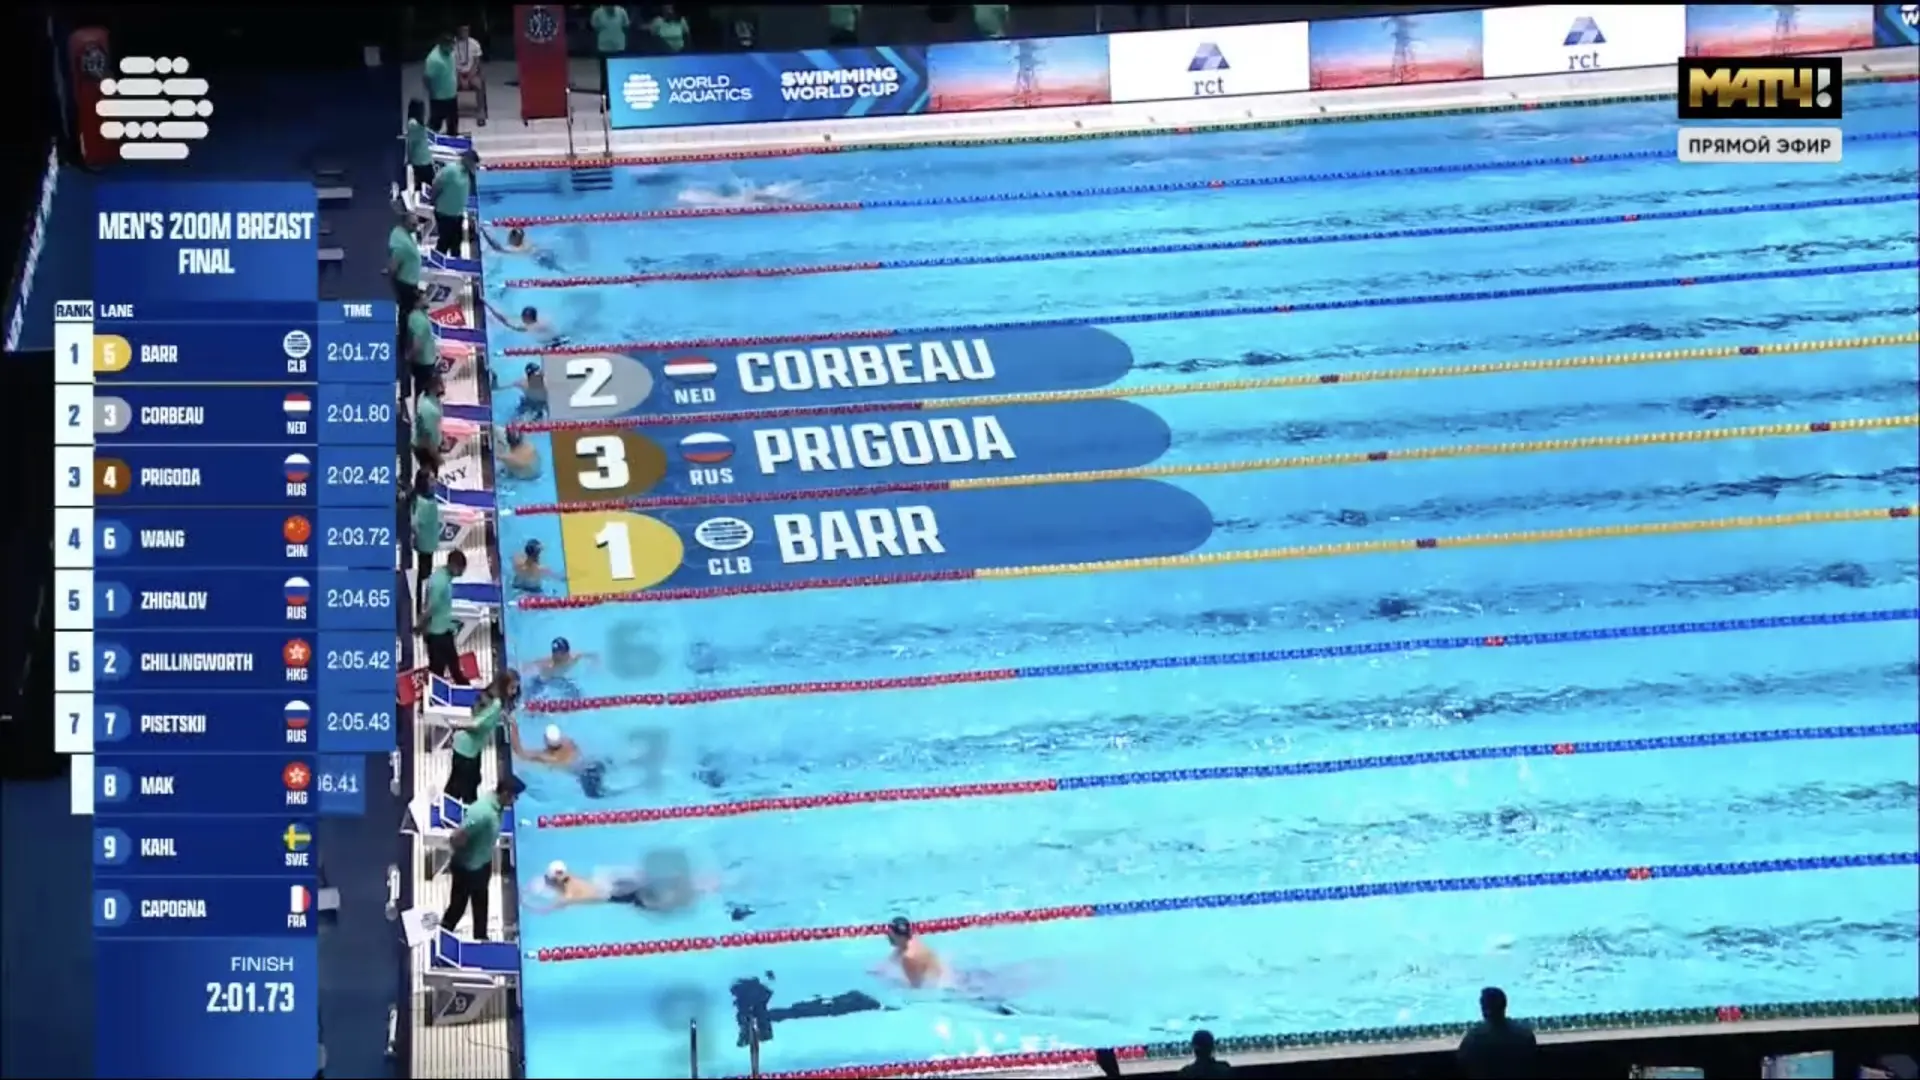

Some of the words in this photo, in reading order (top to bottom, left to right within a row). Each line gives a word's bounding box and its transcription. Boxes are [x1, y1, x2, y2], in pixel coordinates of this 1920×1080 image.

[1568, 50, 1601, 69] rct
[666, 75, 731, 90] WORLD
[780, 67, 898, 87] SWIMMING
[1194, 76, 1225, 95] rct
[668, 87, 753, 104] AQUATICS
[781, 84, 854, 101] WORLD
[857, 82, 900, 98] CUP
